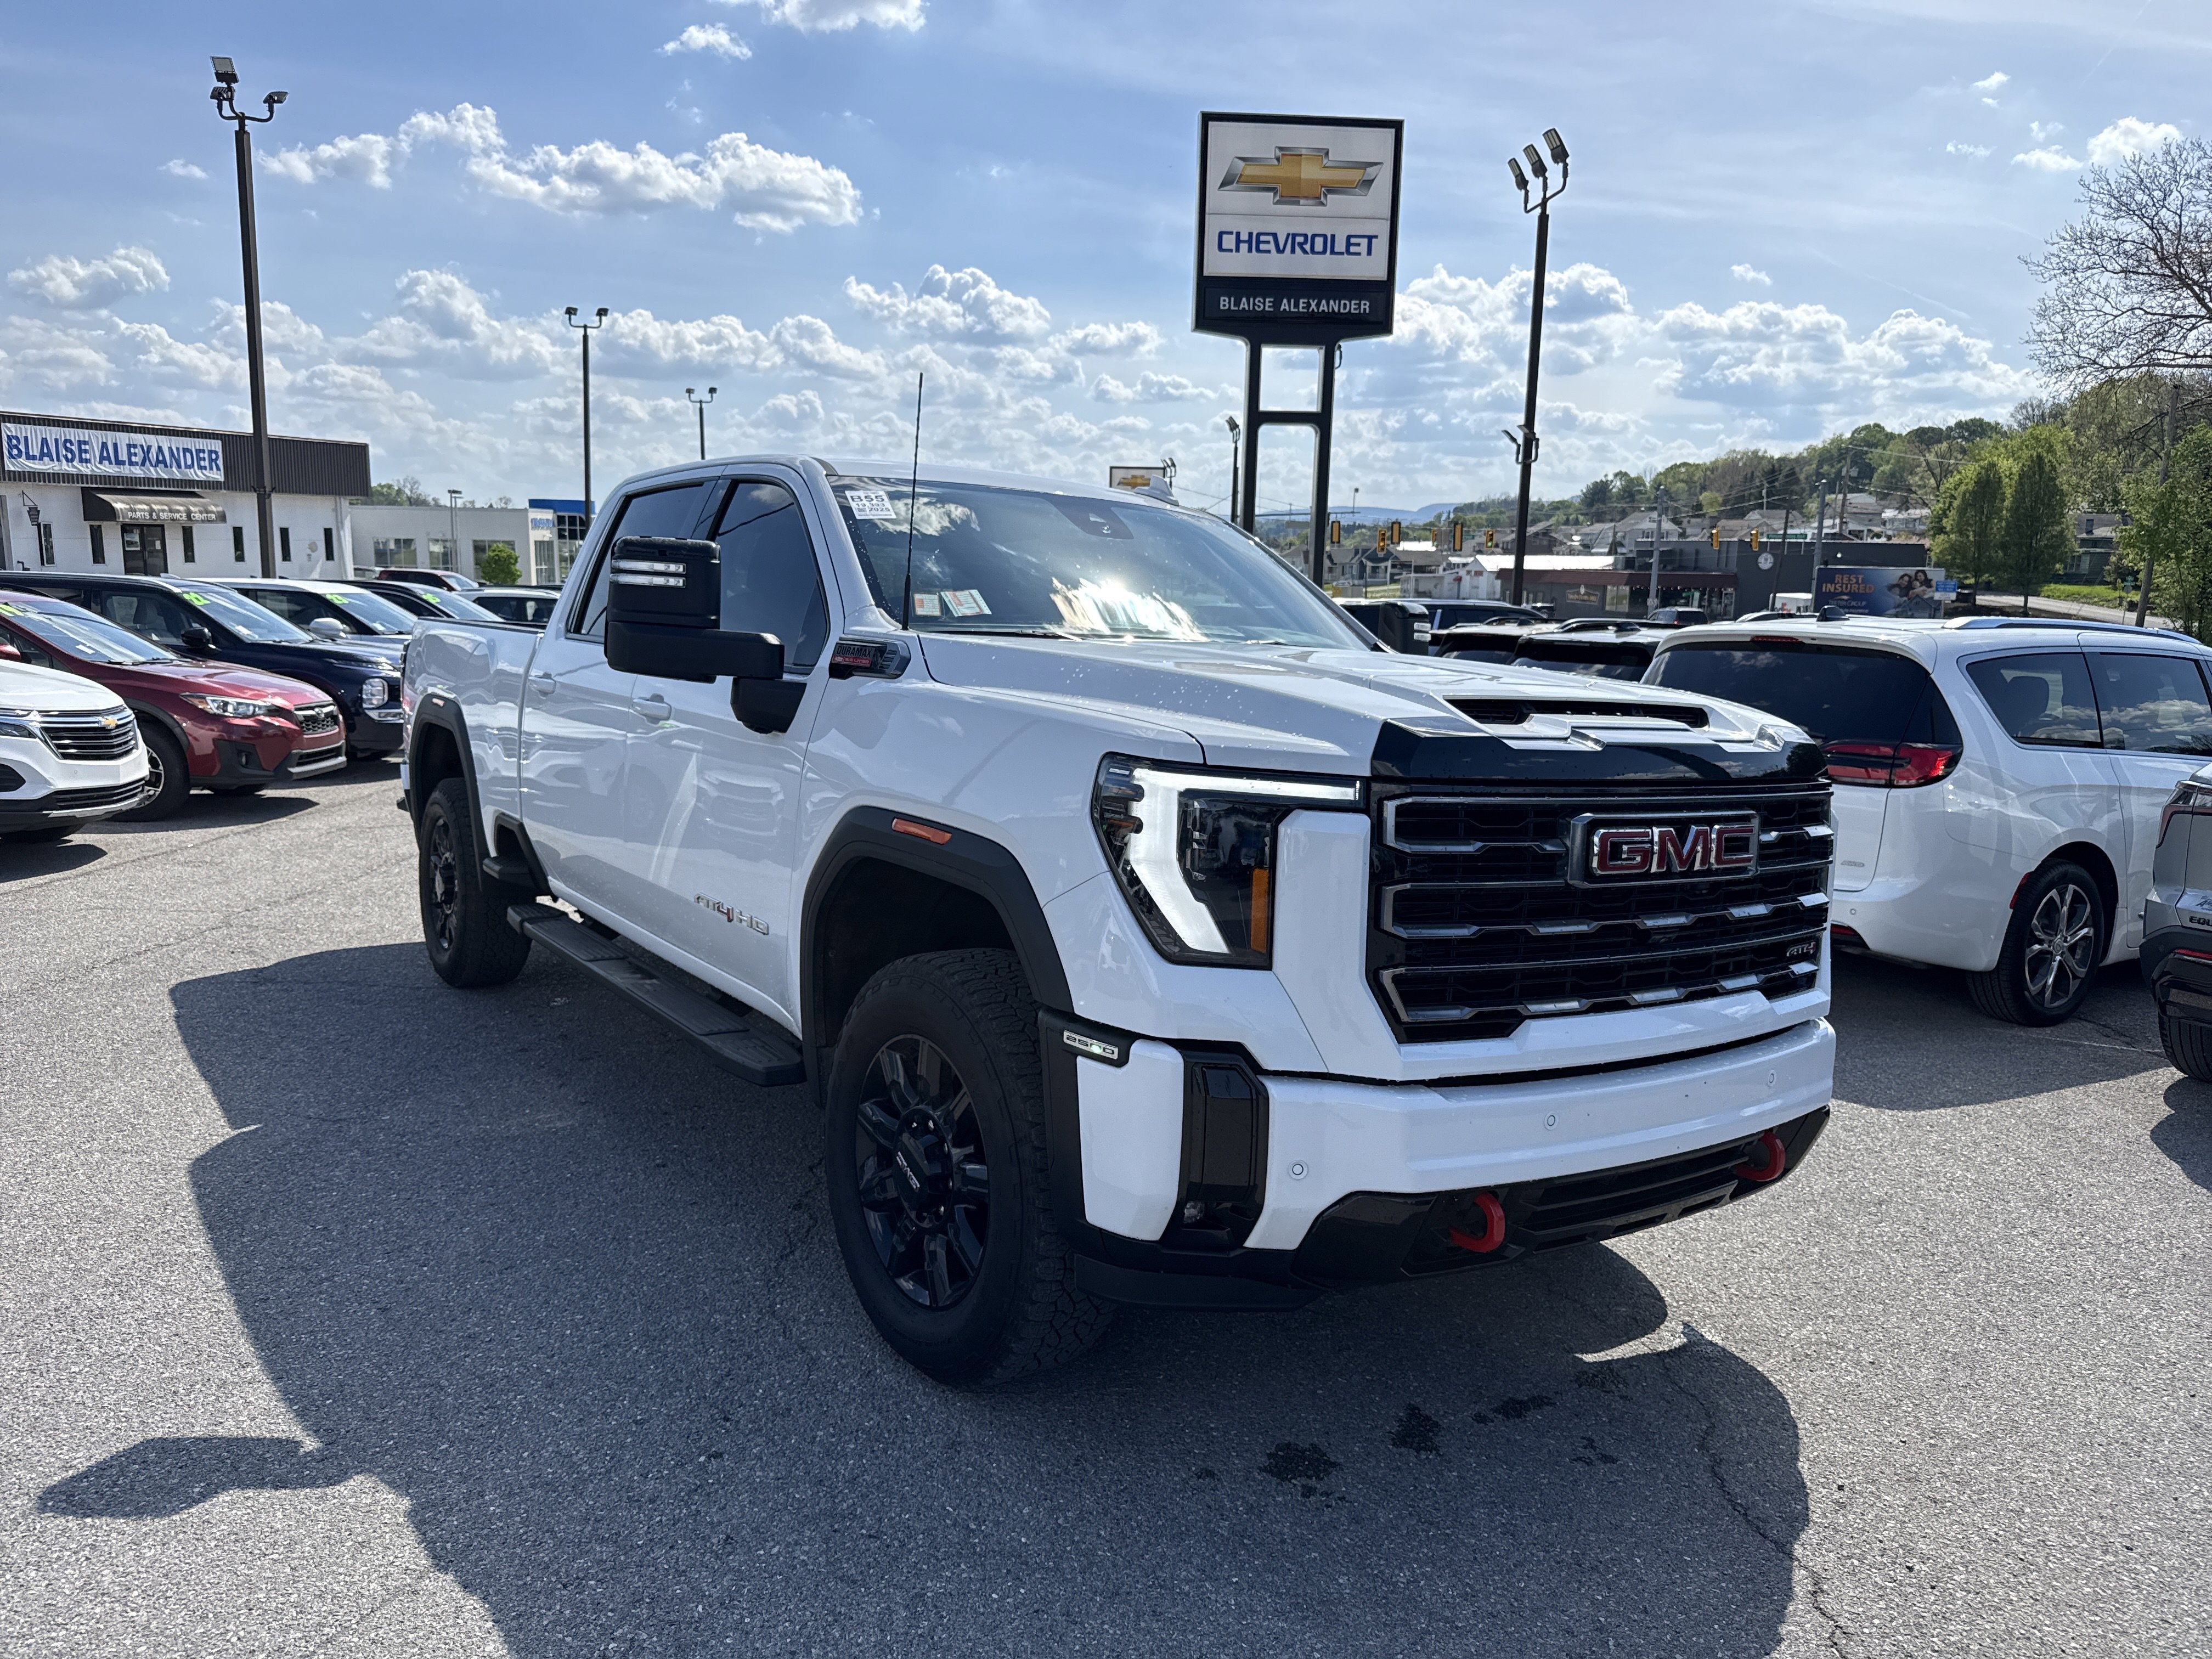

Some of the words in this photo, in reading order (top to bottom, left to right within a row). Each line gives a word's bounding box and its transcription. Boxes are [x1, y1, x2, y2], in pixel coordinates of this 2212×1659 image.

[1217, 231, 1378, 256] CHEVROLET
[1220, 297, 1274, 311] BLAISE
[1280, 298, 1370, 313] ALEXANDER
[6, 435, 91, 464] BLAISE
[98, 441, 220, 471] ALEXANDER
[1822, 583, 1875, 593] INSURED
[1835, 574, 1864, 584] REST
[837, 646, 872, 657] DURAMAX
[1592, 825, 1754, 874] GMC
[694, 892, 733, 923] AT4
[736, 910, 769, 935] HD
[1786, 941, 1816, 957] AT4
[896, 1152, 920, 1192] GMC
